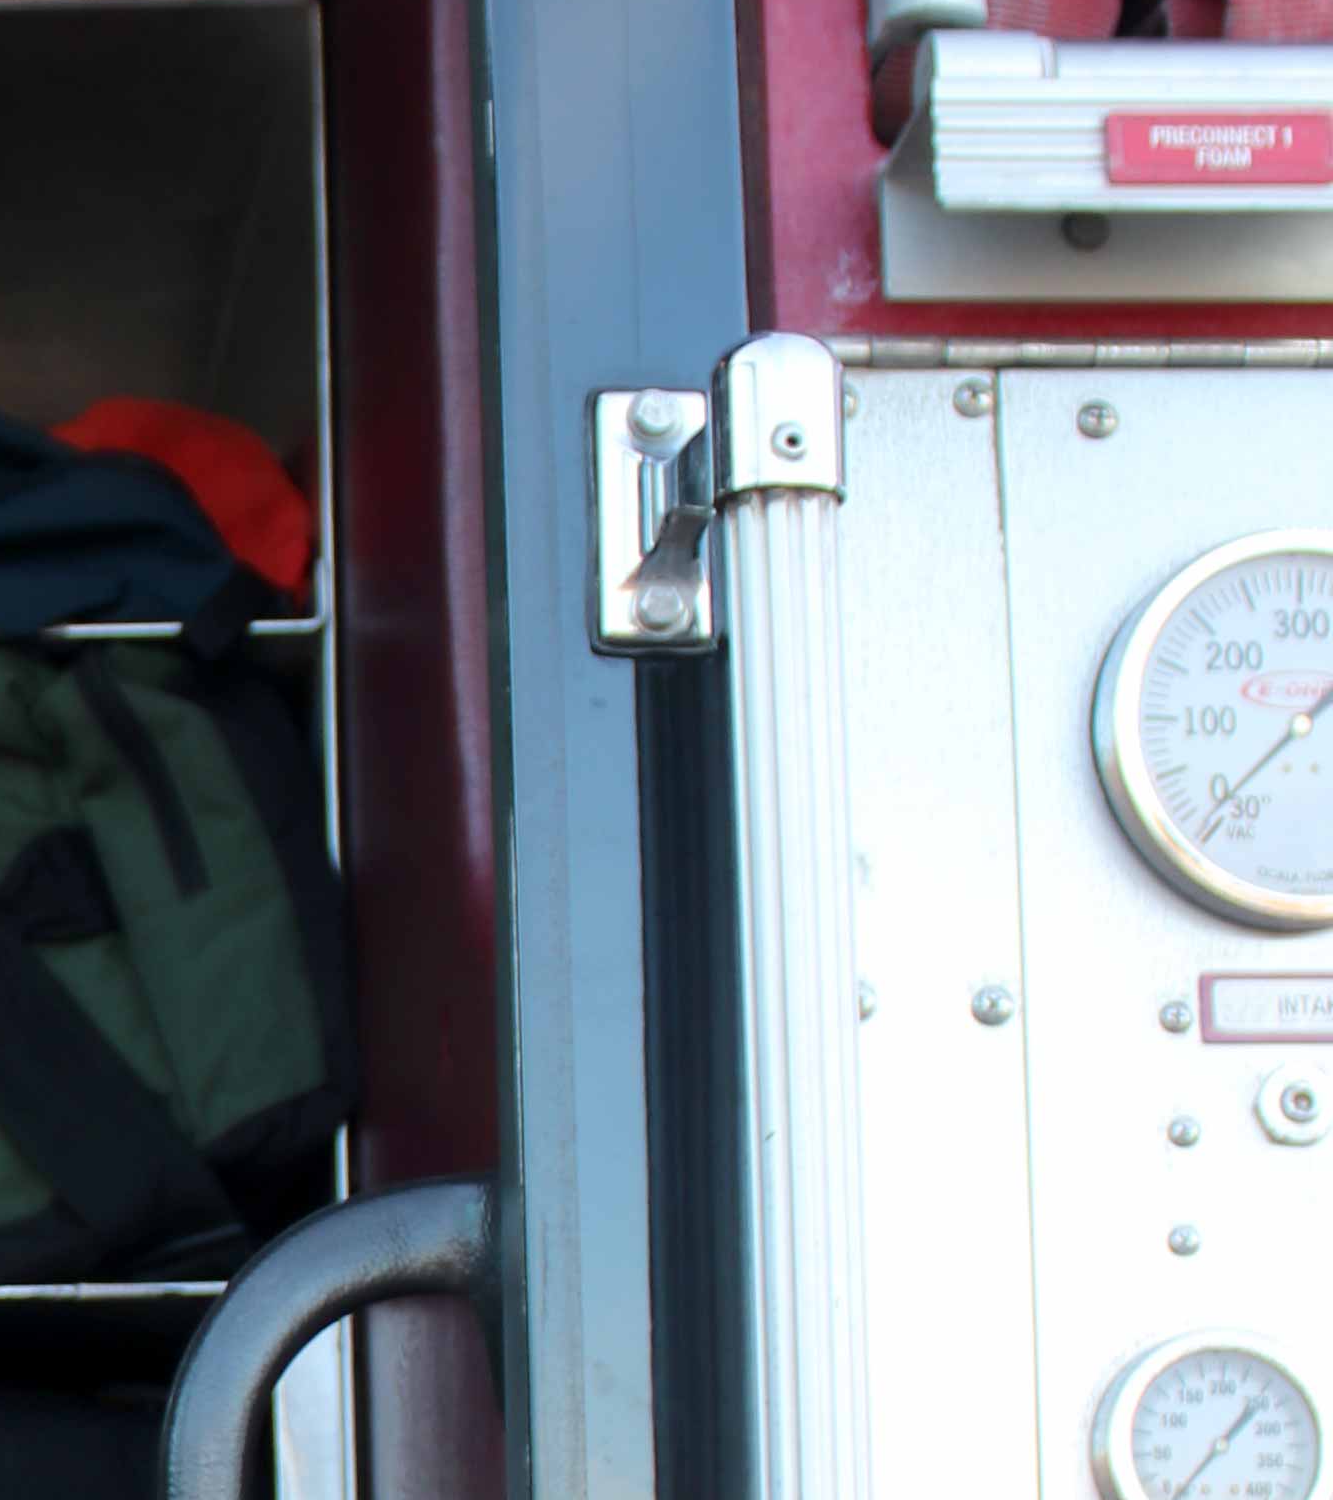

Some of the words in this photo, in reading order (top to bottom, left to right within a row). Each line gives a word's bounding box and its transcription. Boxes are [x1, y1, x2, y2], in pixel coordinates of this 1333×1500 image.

[1149, 124, 1277, 148] PRECONNECT
[1195, 147, 1252, 170] FOAM
[1273, 609, 1331, 640] 300
[1205, 641, 1263, 671] 200
[1184, 706, 1236, 736] 100
[1210, 773, 1229, 803] 0
[1177, 1388, 1203, 1404] 150
[1209, 1380, 1237, 1395] 200
[1161, 1413, 1187, 1428] 100
[1255, 1420, 1281, 1436] 300
[1153, 1445, 1172, 1460] 50
[1257, 1453, 1284, 1468] 350
